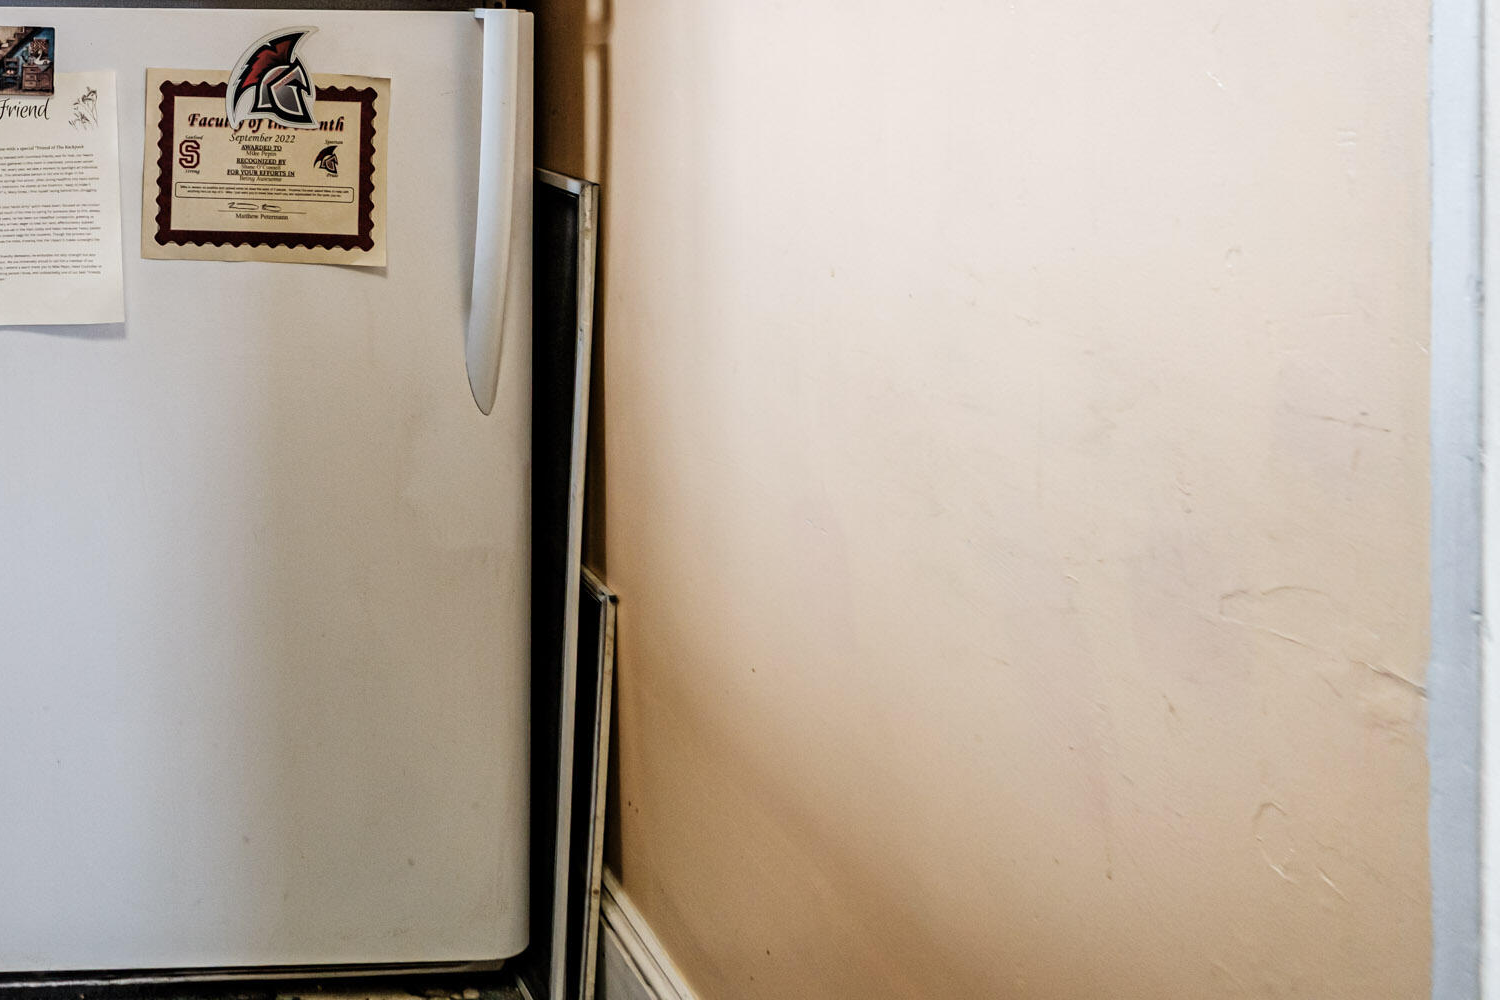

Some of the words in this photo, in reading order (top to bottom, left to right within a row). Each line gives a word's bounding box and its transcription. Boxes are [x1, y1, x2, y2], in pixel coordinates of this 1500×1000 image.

[188, 113, 245, 133] Faculy
[228, 132, 273, 144] September
[274, 134, 296, 144] 2022
[179, 139, 200, 169] S
